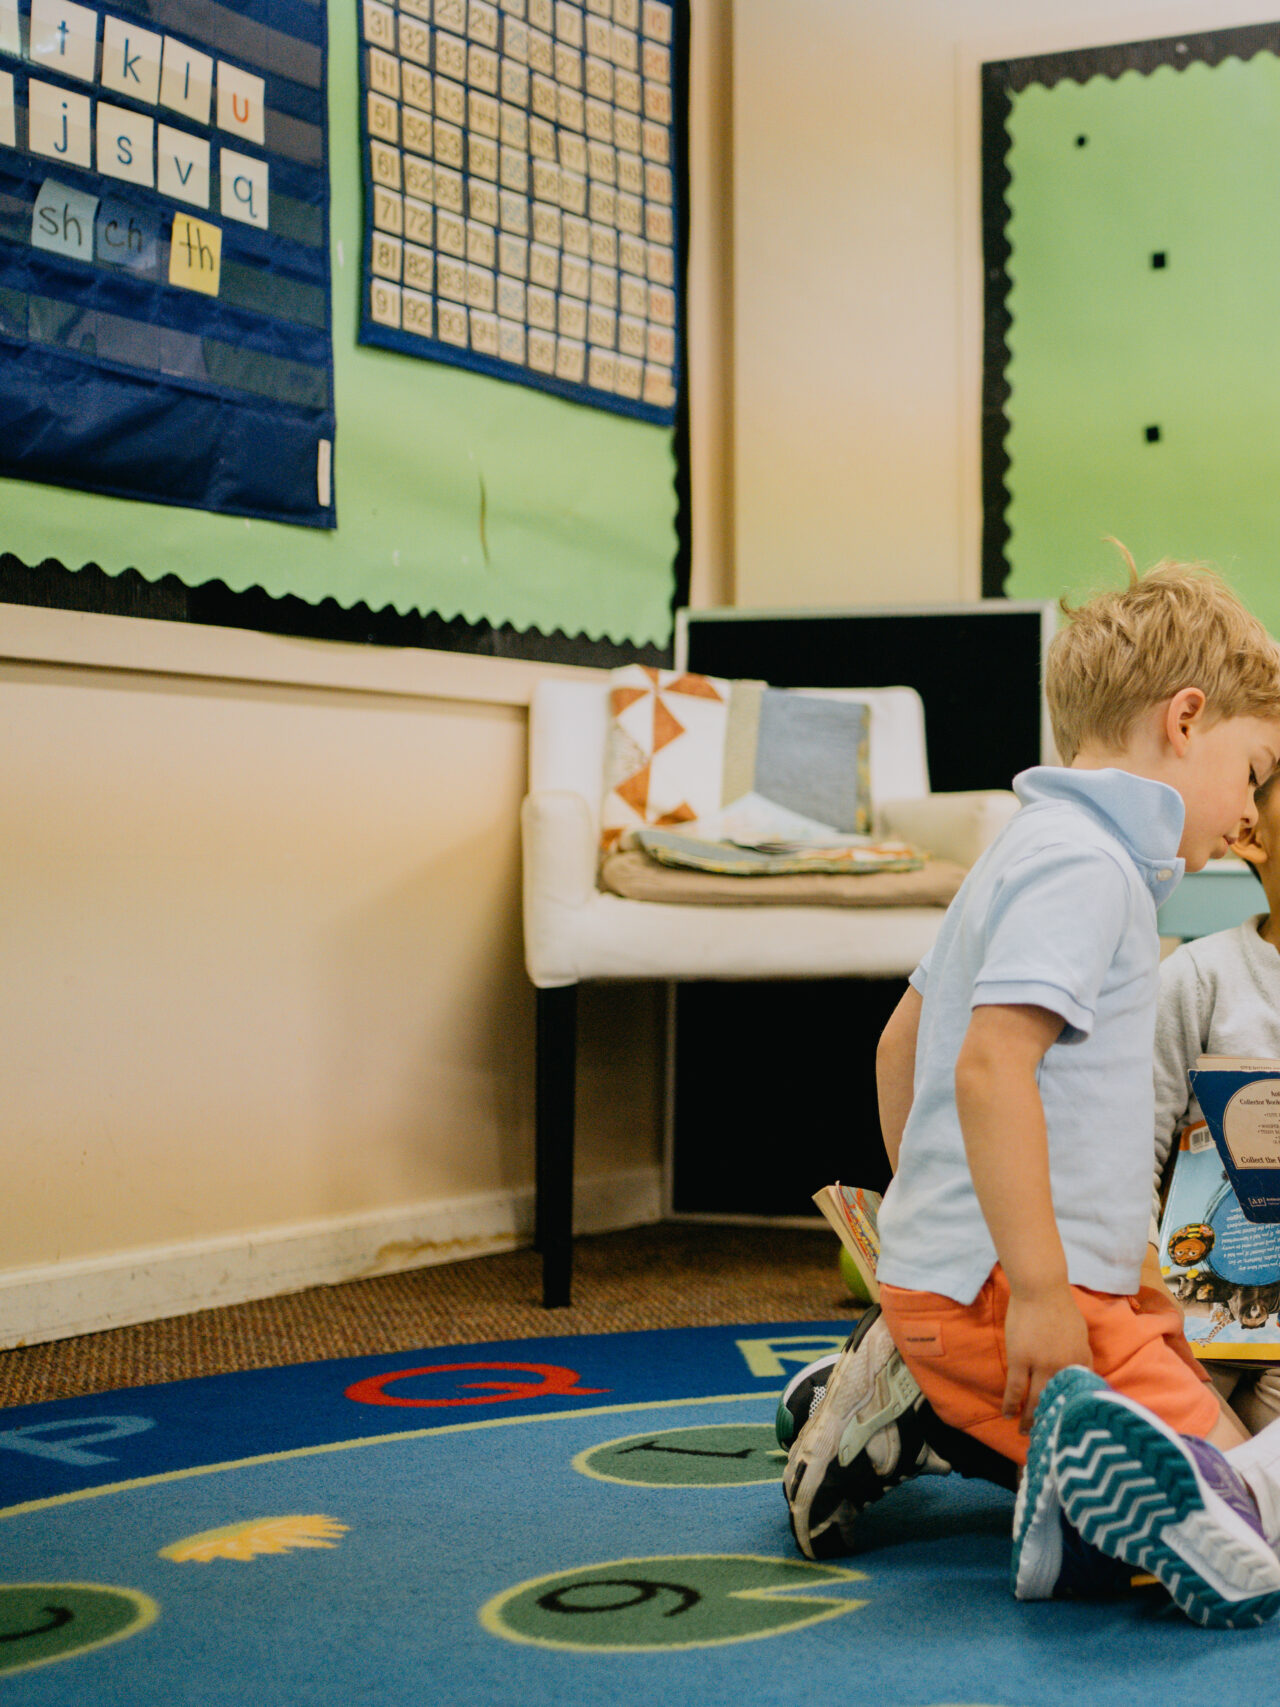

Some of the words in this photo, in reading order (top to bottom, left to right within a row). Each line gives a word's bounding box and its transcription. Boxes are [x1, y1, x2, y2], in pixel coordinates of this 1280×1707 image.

[371, 10, 389, 36] 31
[401, 24, 425, 50] 32
[57, 20, 69, 55] t
[123, 38, 141, 83] k
[232, 92, 249, 123] u
[374, 104, 392, 129] 51
[54, 102, 68, 153] j
[117, 136, 132, 165] s
[174, 156, 193, 185] v
[233, 176, 257, 218] q
[39, 203, 82, 246] sh
[104, 219, 142, 252] ch
[179, 221, 214, 272] th
[379, 196, 396, 222] 71
[406, 208, 429, 236] 72
[440, 219, 462, 246] 73
[378, 241, 396, 269] 81
[407, 254, 429, 281] 82
[376, 289, 396, 316] 91
[405, 299, 429, 323] 92
[439, 309, 463, 334] 93
[1241, 1156, 1264, 1164] Collect
[344, 1361, 614, 1408] Q
[0, 1414, 157, 1467] P
